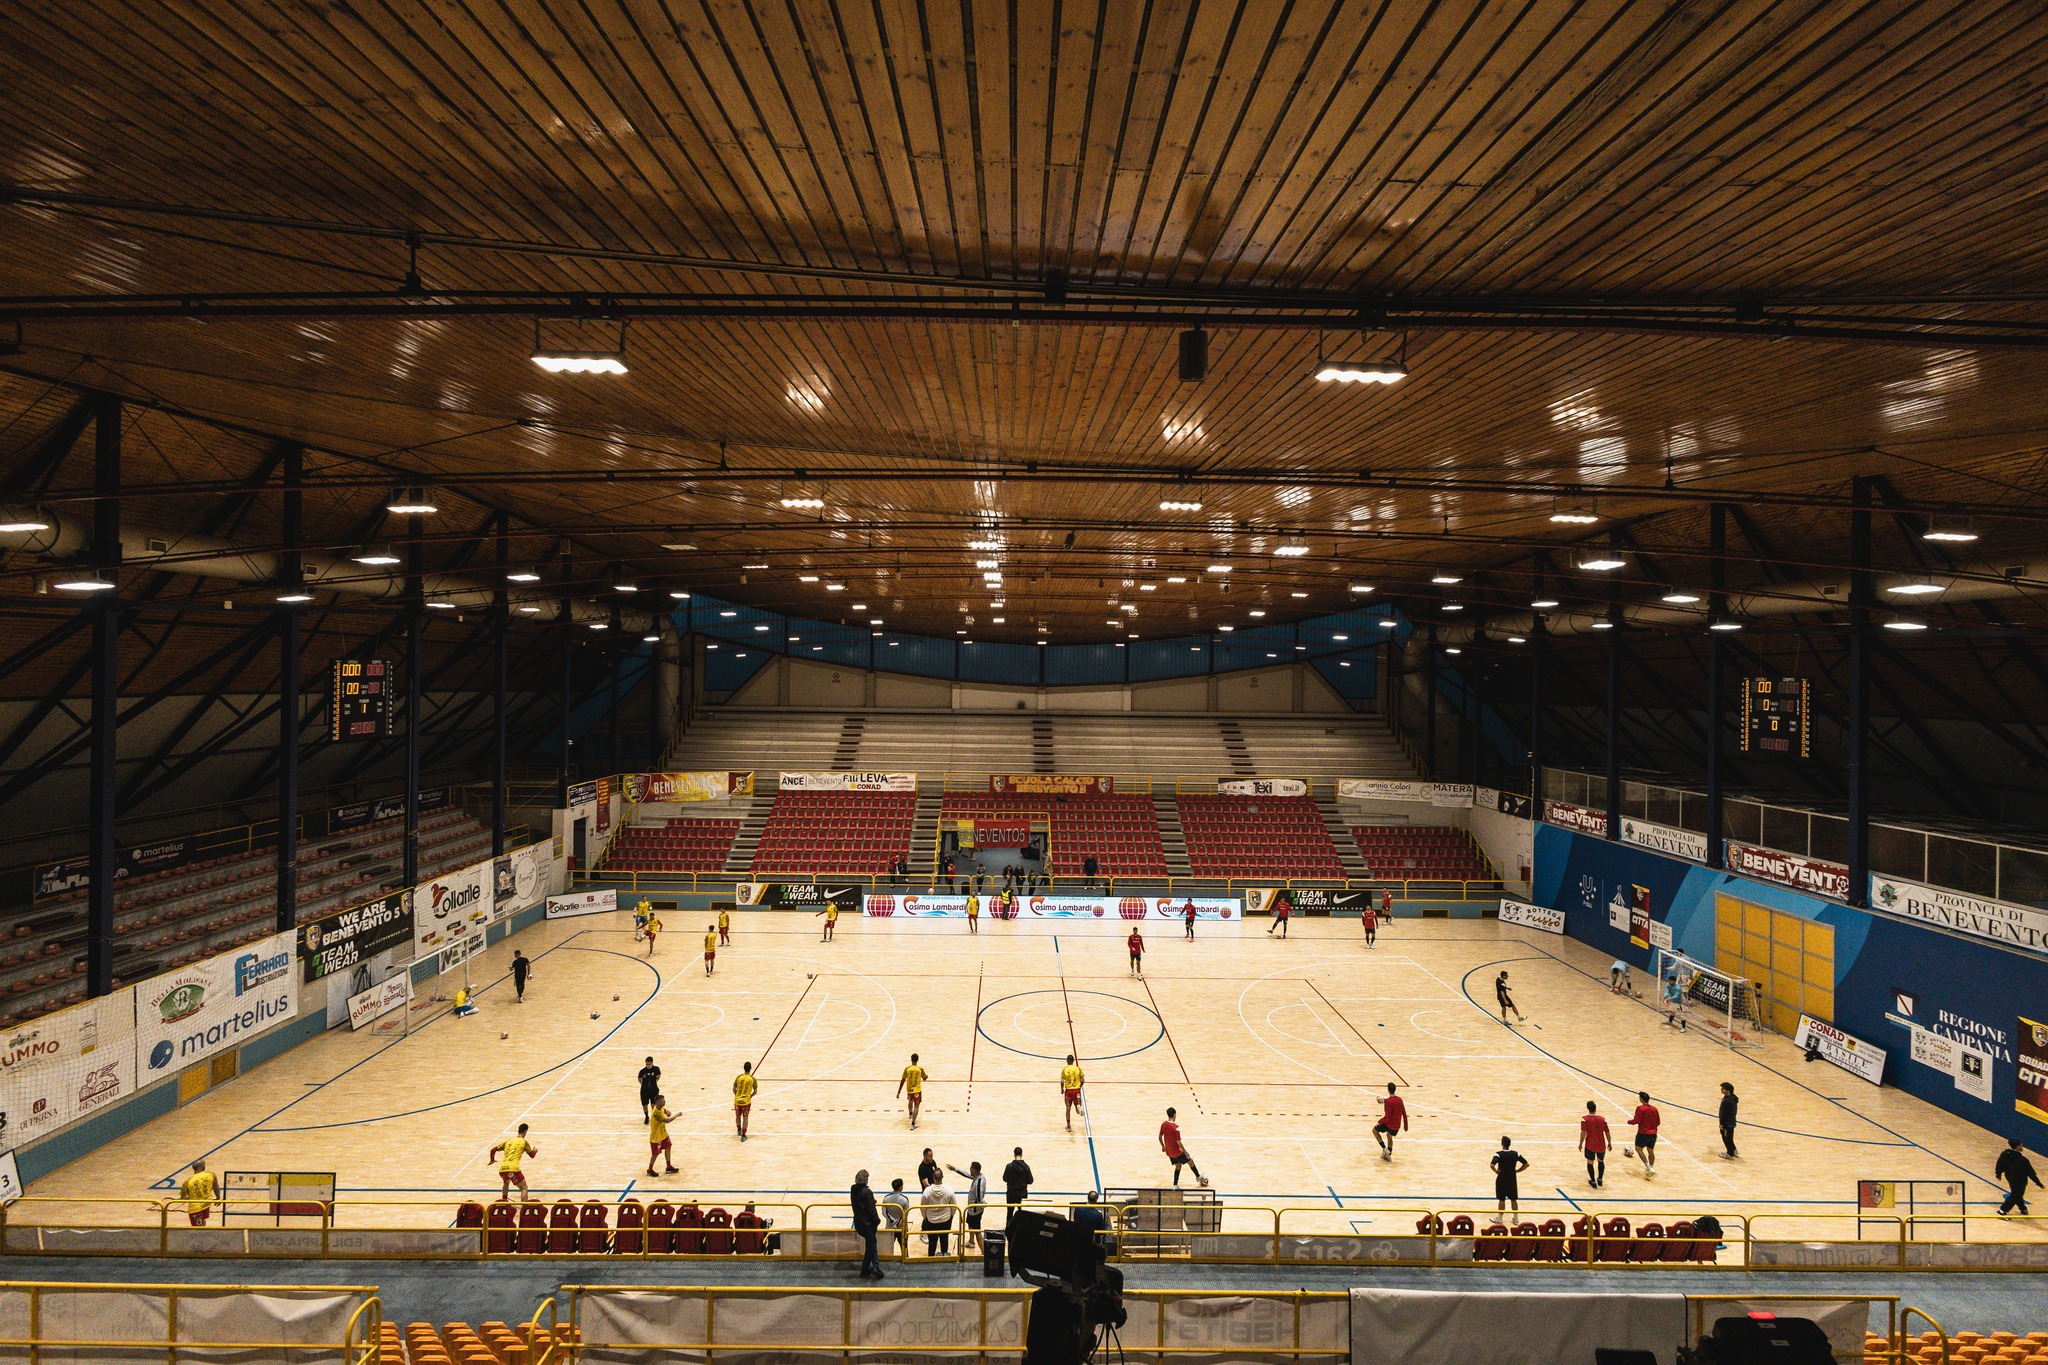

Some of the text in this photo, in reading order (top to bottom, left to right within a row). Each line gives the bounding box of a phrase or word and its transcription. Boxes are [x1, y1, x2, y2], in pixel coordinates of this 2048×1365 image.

[342, 664, 361, 677] 000
[346, 682, 359, 695] 00
[1758, 681, 1771, 693] 00
[1763, 699, 1770, 711] 0
[1772, 720, 1778, 730] 0
[781, 777, 804, 786] ANCE
[860, 773, 888, 783] LEVA
[1365, 781, 1411, 790] Sannio Colori
[1252, 781, 1272, 794] Texi
[1283, 784, 1300, 792] texi.it
[1433, 784, 1473, 792] MATERA
[1652, 826, 1696, 843] PROVINCIA DI
[143, 842, 184, 858] martelius
[787, 884, 814, 893] TEAM
[788, 892, 818, 900] WEAR
[1296, 890, 1324, 898] TEAM
[1194, 905, 1220, 913] mbardi
[1299, 897, 1328, 906] WEAR
[1935, 893, 2024, 922] PROVINCIA DI
[338, 900, 387, 928] WE ARE
[1526, 908, 1561, 921] BOTTEGA
[1526, 914, 1560, 927] russo
[322, 910, 392, 947] BENEVENTO
[394, 906, 400, 919] 5
[321, 940, 355, 964] TEAM
[324, 951, 359, 975] WEAR
[1703, 978, 1726, 994] TEAM
[150, 985, 175, 1008] BELLA
[1703, 986, 1727, 1002] WEAR
[352, 1000, 382, 1020] RUMMO
[181, 995, 288, 1057] martelius
[1810, 1020, 1845, 1042] CONAD
[1939, 1009, 2007, 1045] REGIONE
[1932, 1024, 2012, 1064] CAMPANIA
[0, 1040, 60, 1071] UMMO
[1826, 1043, 1868, 1069] BASILE
[79, 1086, 120, 1112] GENERALI
[29, 1108, 58, 1127] PERNA
[1, 1174, 10, 1188] 3
